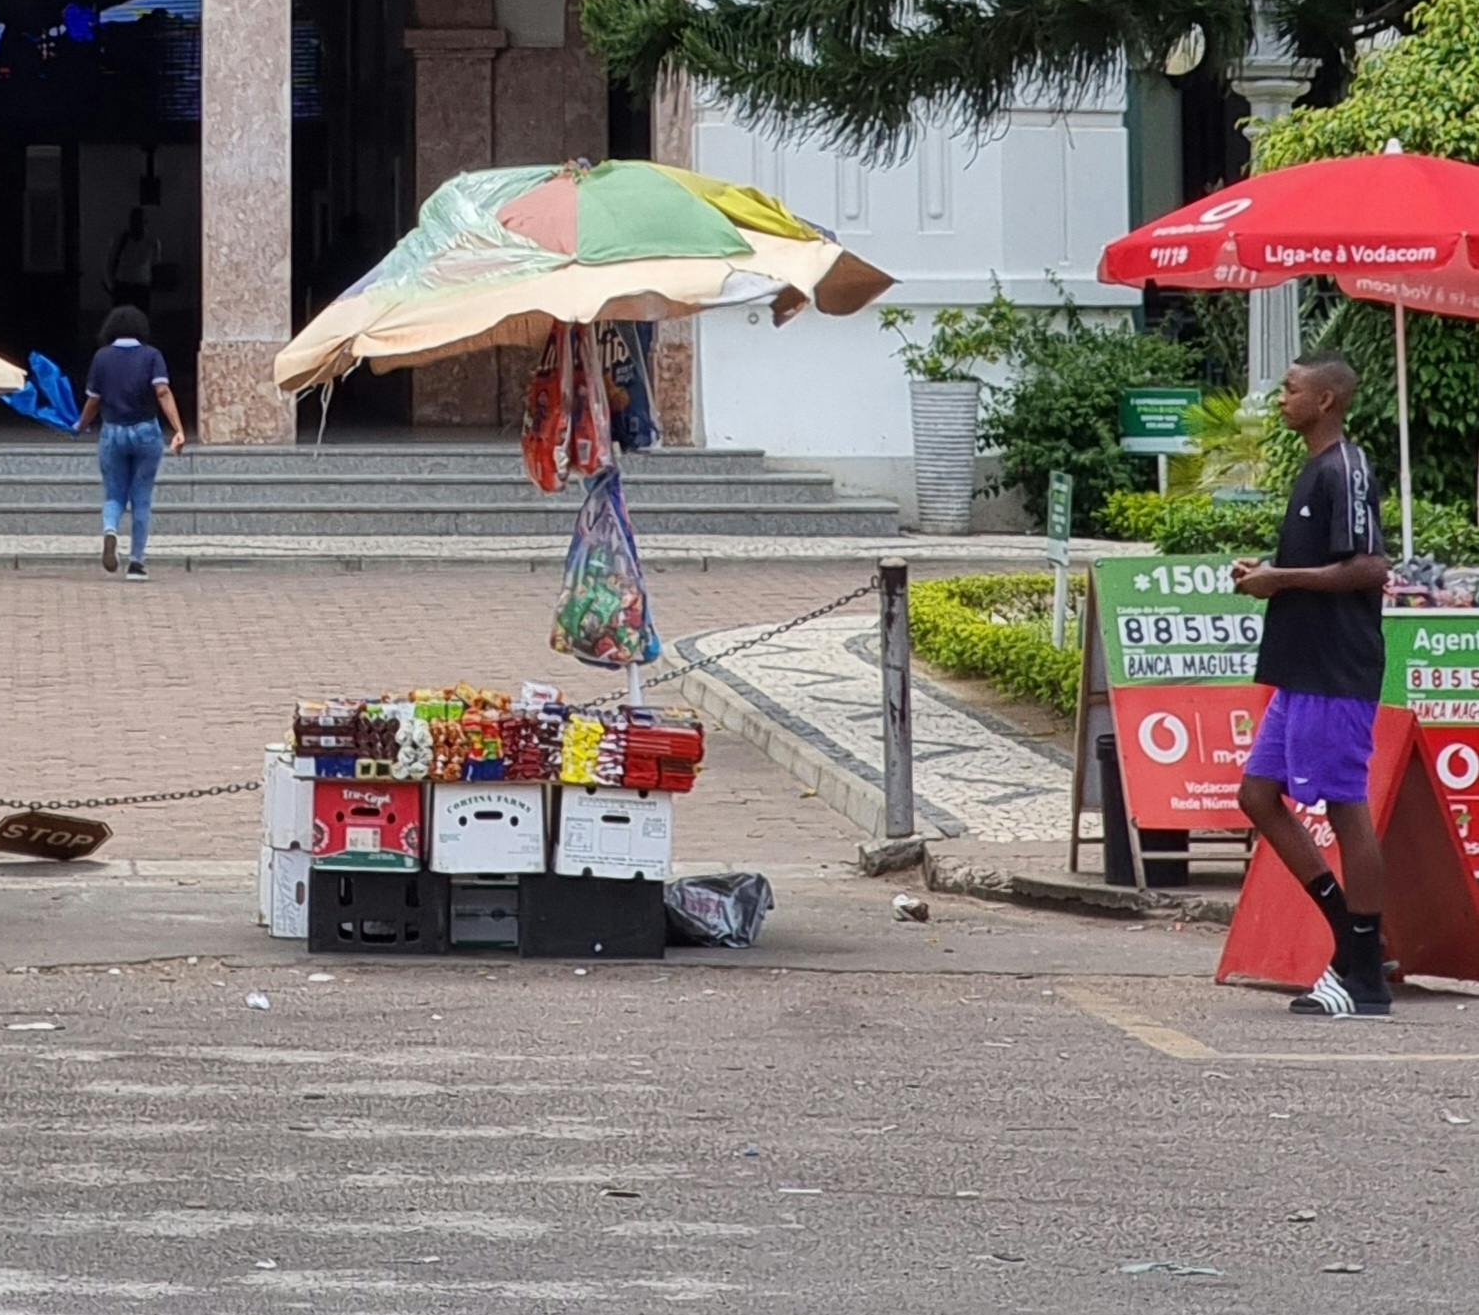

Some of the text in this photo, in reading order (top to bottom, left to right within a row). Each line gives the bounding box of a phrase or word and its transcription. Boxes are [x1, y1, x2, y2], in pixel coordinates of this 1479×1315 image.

[1265, 244, 1332, 267] Liga-te
[1351, 245, 1436, 263] Vodacom
[1124, 616, 1257, 644] 88556
[1202, 796, 1239, 810] Núme
[2, 824, 94, 847] STOP
